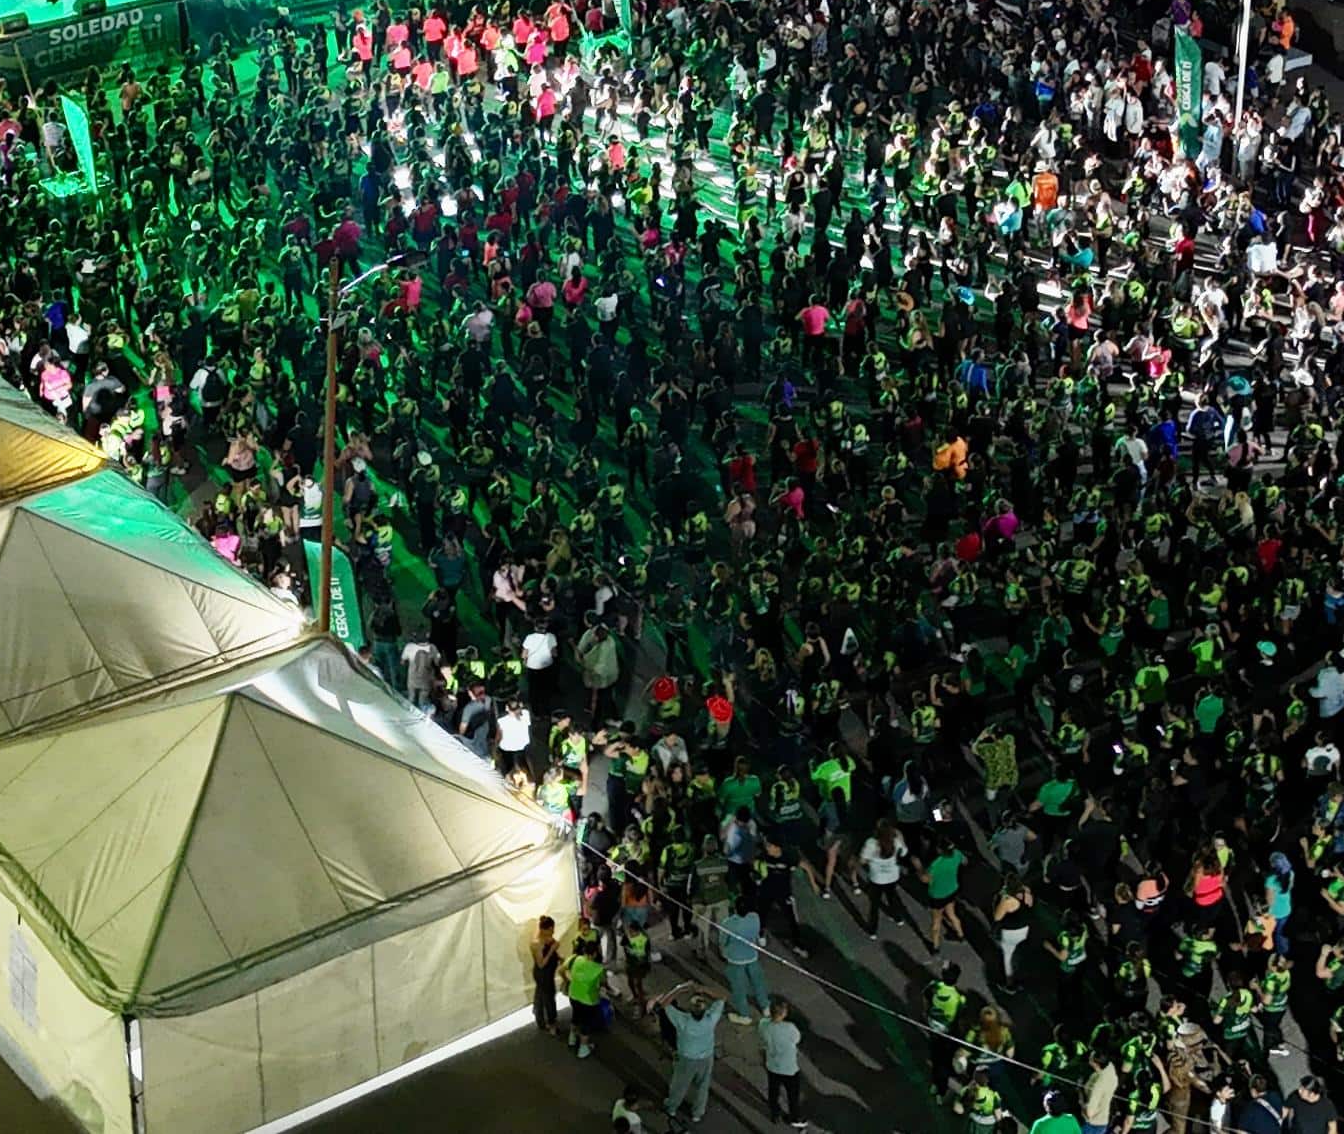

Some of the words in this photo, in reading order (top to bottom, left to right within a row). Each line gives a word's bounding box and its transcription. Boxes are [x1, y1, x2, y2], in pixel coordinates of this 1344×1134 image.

[48, 7, 145, 46] SOLEDAD
[331, 586, 344, 600] DE
[334, 602, 350, 639] CERCA
